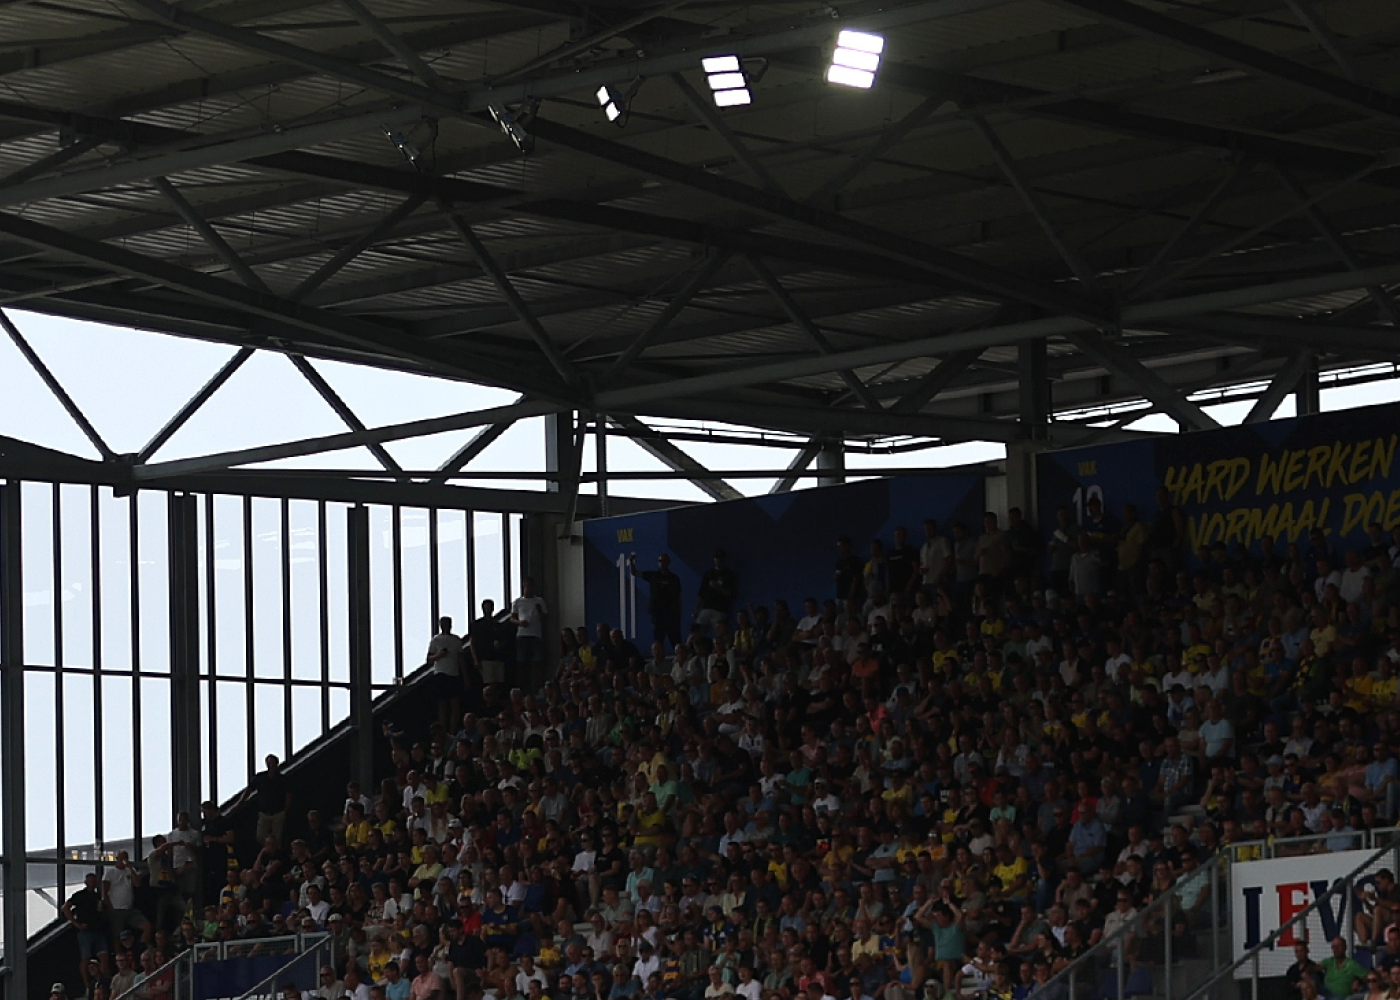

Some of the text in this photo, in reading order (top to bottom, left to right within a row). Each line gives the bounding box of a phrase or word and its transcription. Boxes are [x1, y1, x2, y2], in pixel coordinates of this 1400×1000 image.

[1165, 434, 1398, 505] HARD WERKEN
[1186, 497, 1333, 555] NORMAAL
